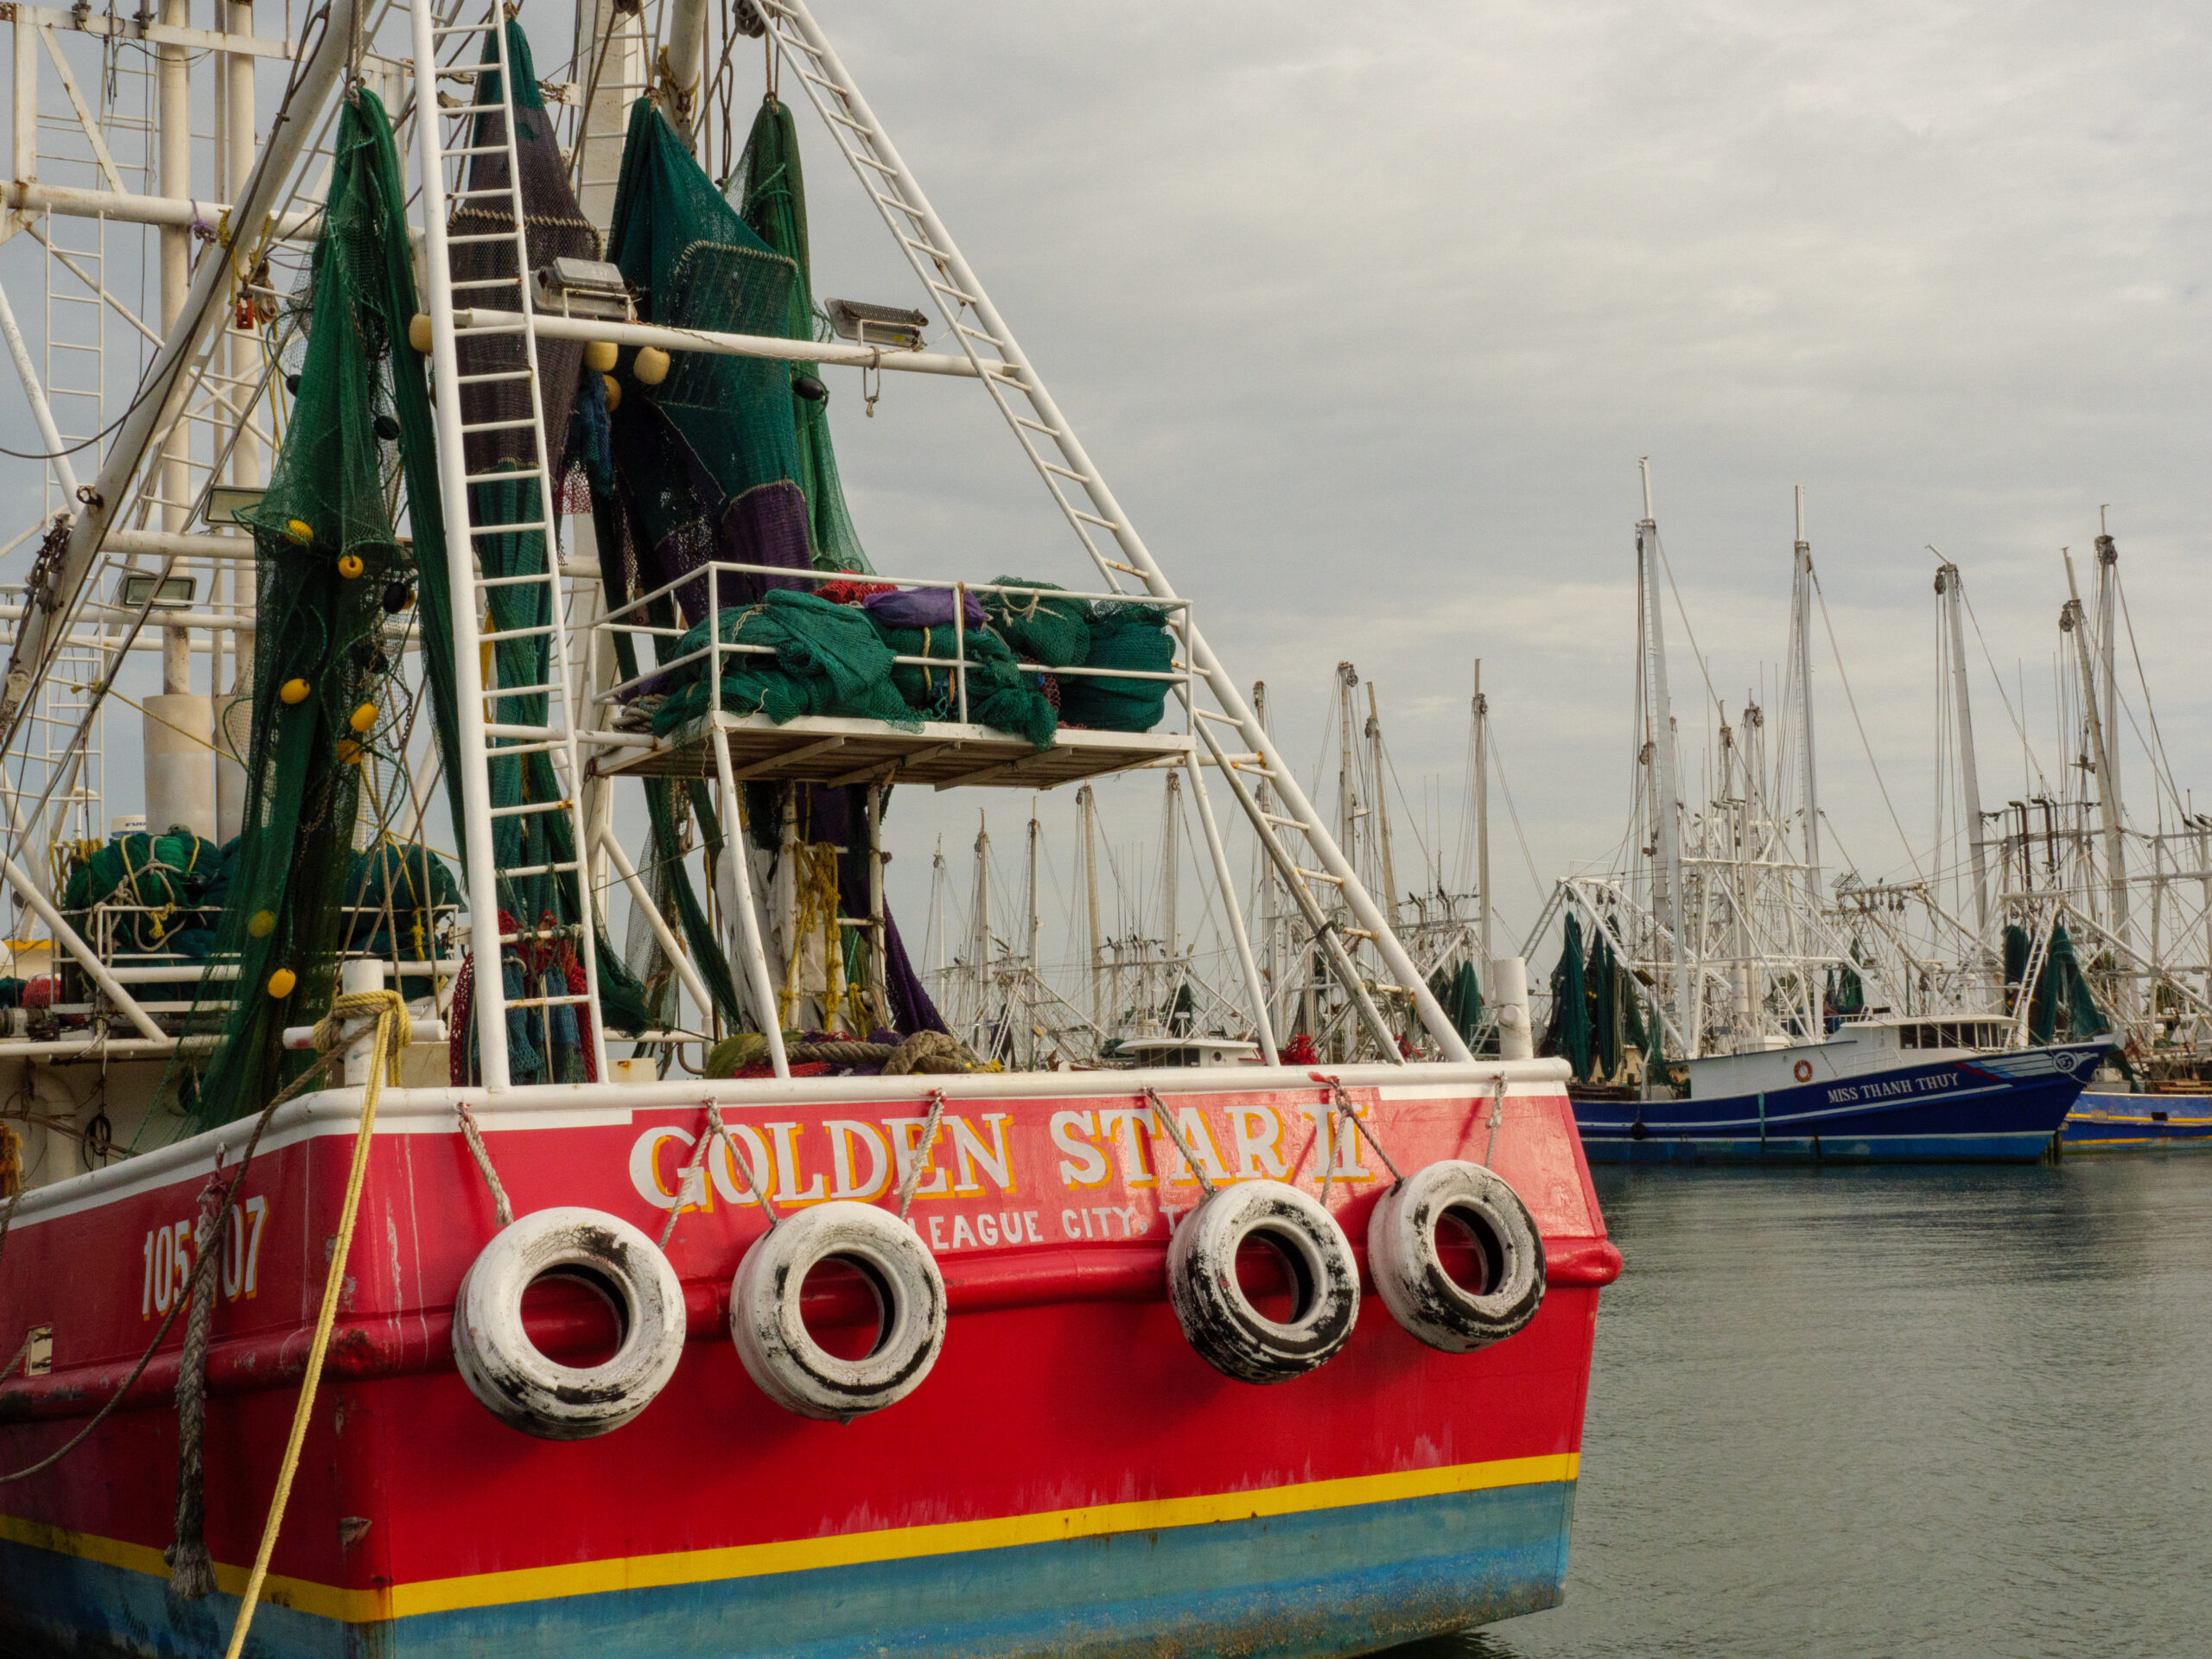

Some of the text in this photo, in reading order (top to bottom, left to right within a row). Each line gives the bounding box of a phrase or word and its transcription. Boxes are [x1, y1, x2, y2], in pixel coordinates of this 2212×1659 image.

[1827, 1072, 1959, 1103] MISS THANH THUY
[629, 1103, 1376, 1213] GOLDEN STAR II
[1061, 1205, 1150, 1239] CITY,
